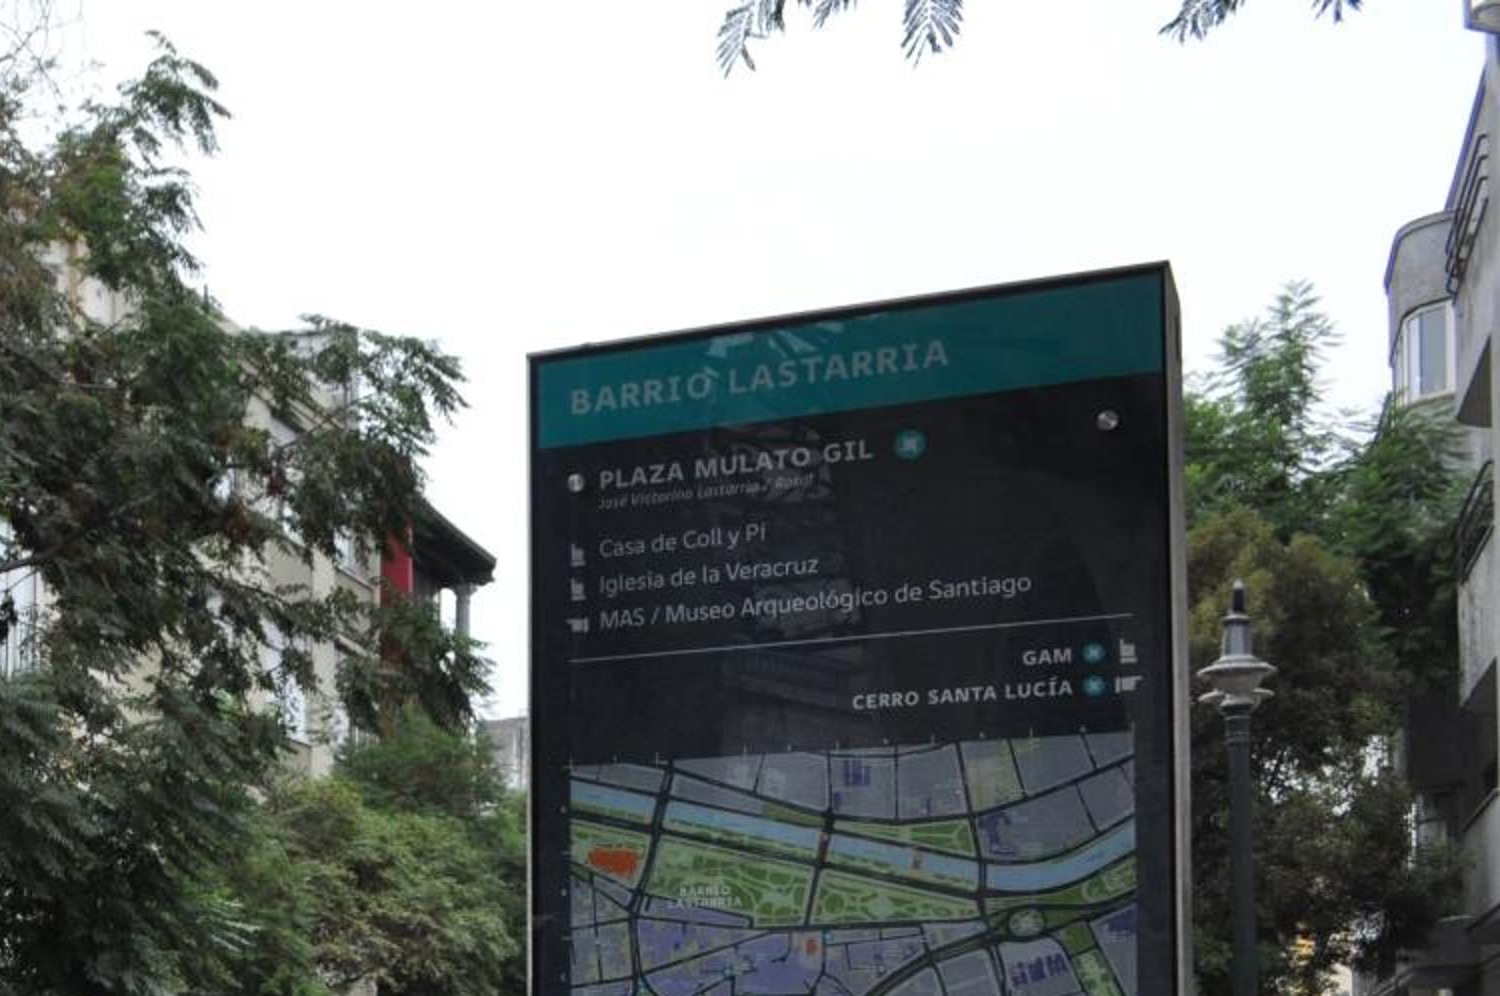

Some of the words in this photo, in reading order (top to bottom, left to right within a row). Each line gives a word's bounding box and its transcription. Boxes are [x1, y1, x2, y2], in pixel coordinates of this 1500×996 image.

[571, 372, 711, 415] BARRIO
[729, 340, 949, 394] LASTARRIA
[600, 462, 683, 490] PLAZA
[695, 447, 810, 479] MULATO
[823, 440, 874, 465] GIL
[600, 538, 646, 558] Casa
[651, 532, 678, 552] de
[683, 527, 721, 550] Coll
[727, 529, 741, 549] y
[600, 570, 665, 597] Iglesia
[670, 566, 697, 587] de
[702, 564, 721, 584] la
[725, 557, 820, 582] Veracruz
[600, 607, 645, 630] MAS
[650, 606, 660, 625] /
[665, 601, 735, 624] Museo
[740, 589, 888, 618] Arqueológico
[894, 583, 923, 602] de
[928, 575, 1032, 599] Santiago
[1022, 647, 1073, 667] GAM
[852, 691, 920, 710] CERRO
[928, 684, 997, 706] SANTA
[1005, 675, 1073, 699] LUCÍA
